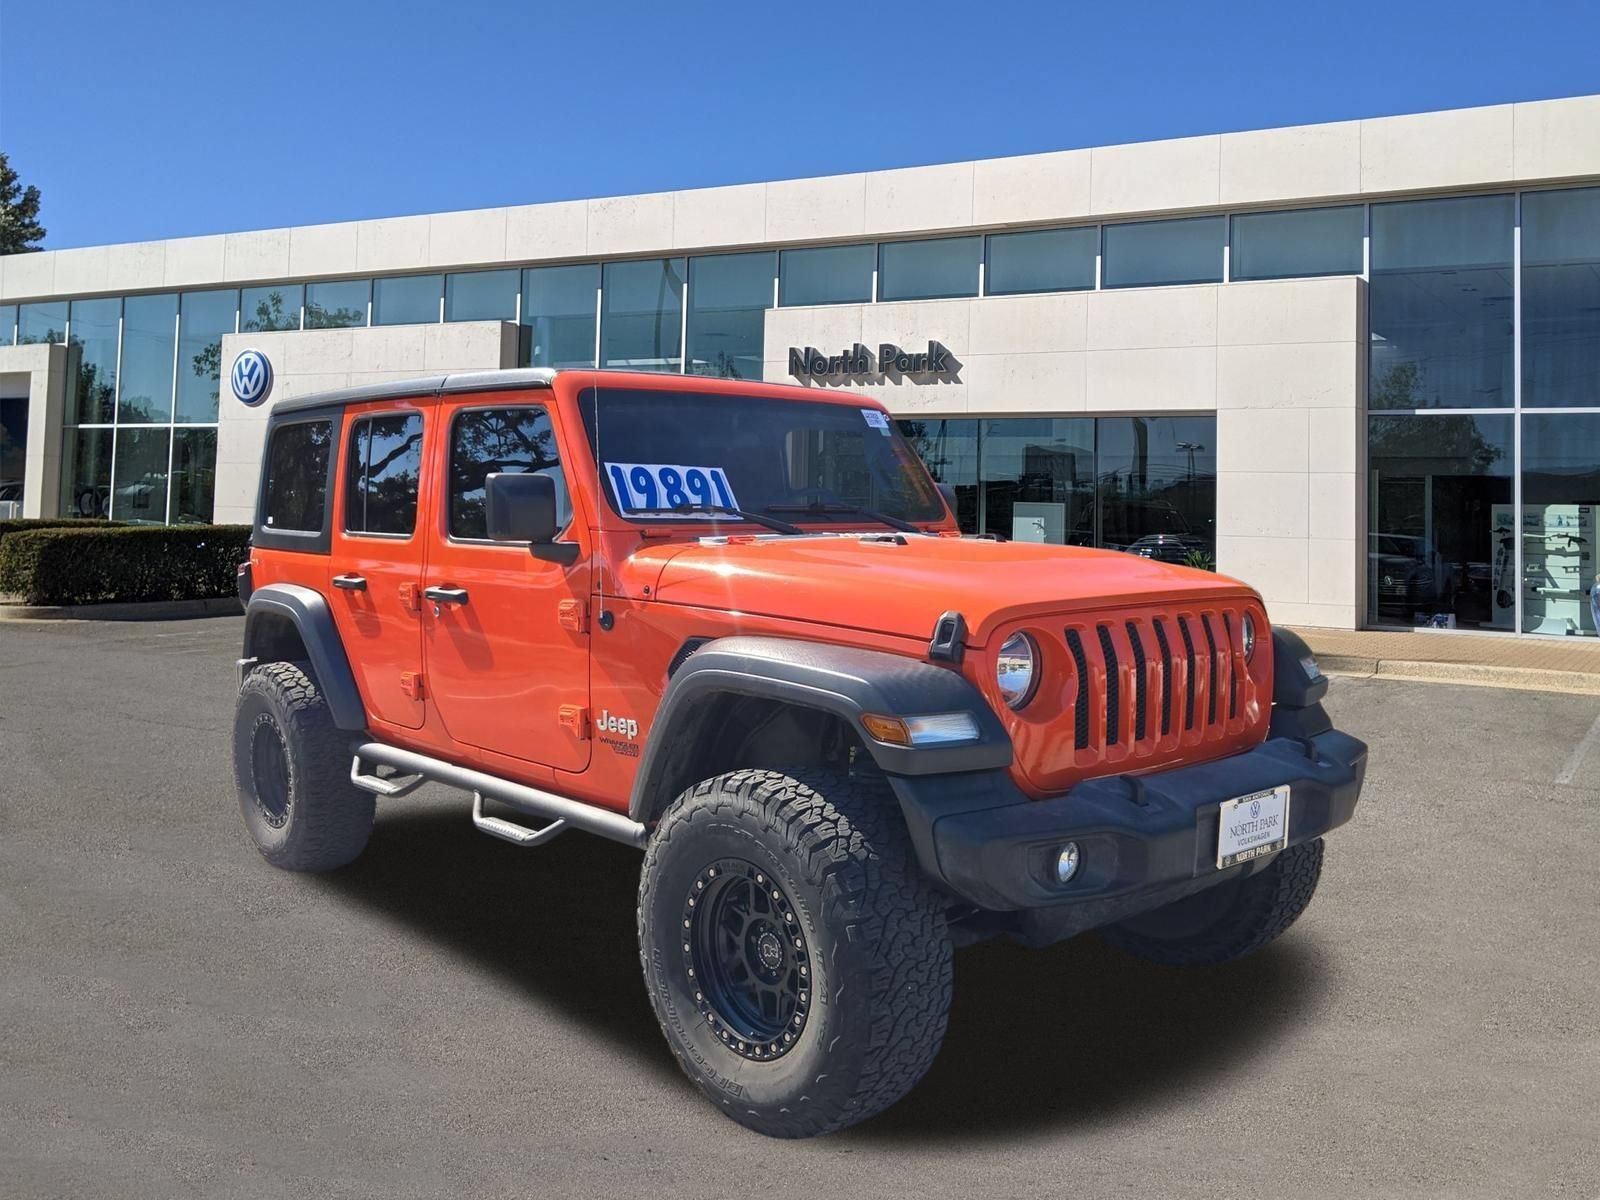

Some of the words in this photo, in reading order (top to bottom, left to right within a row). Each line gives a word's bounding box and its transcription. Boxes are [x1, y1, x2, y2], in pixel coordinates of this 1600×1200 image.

[788, 343, 872, 376] North
[878, 340, 951, 374] Park
[232, 351, 271, 404] VW
[610, 465, 735, 510] 19891
[596, 709, 638, 740] Jeep
[1230, 820, 1258, 838] NORTH
[1259, 814, 1279, 831] PARK
[1236, 849, 1256, 861] NORTH
[1256, 844, 1272, 856] PARK
